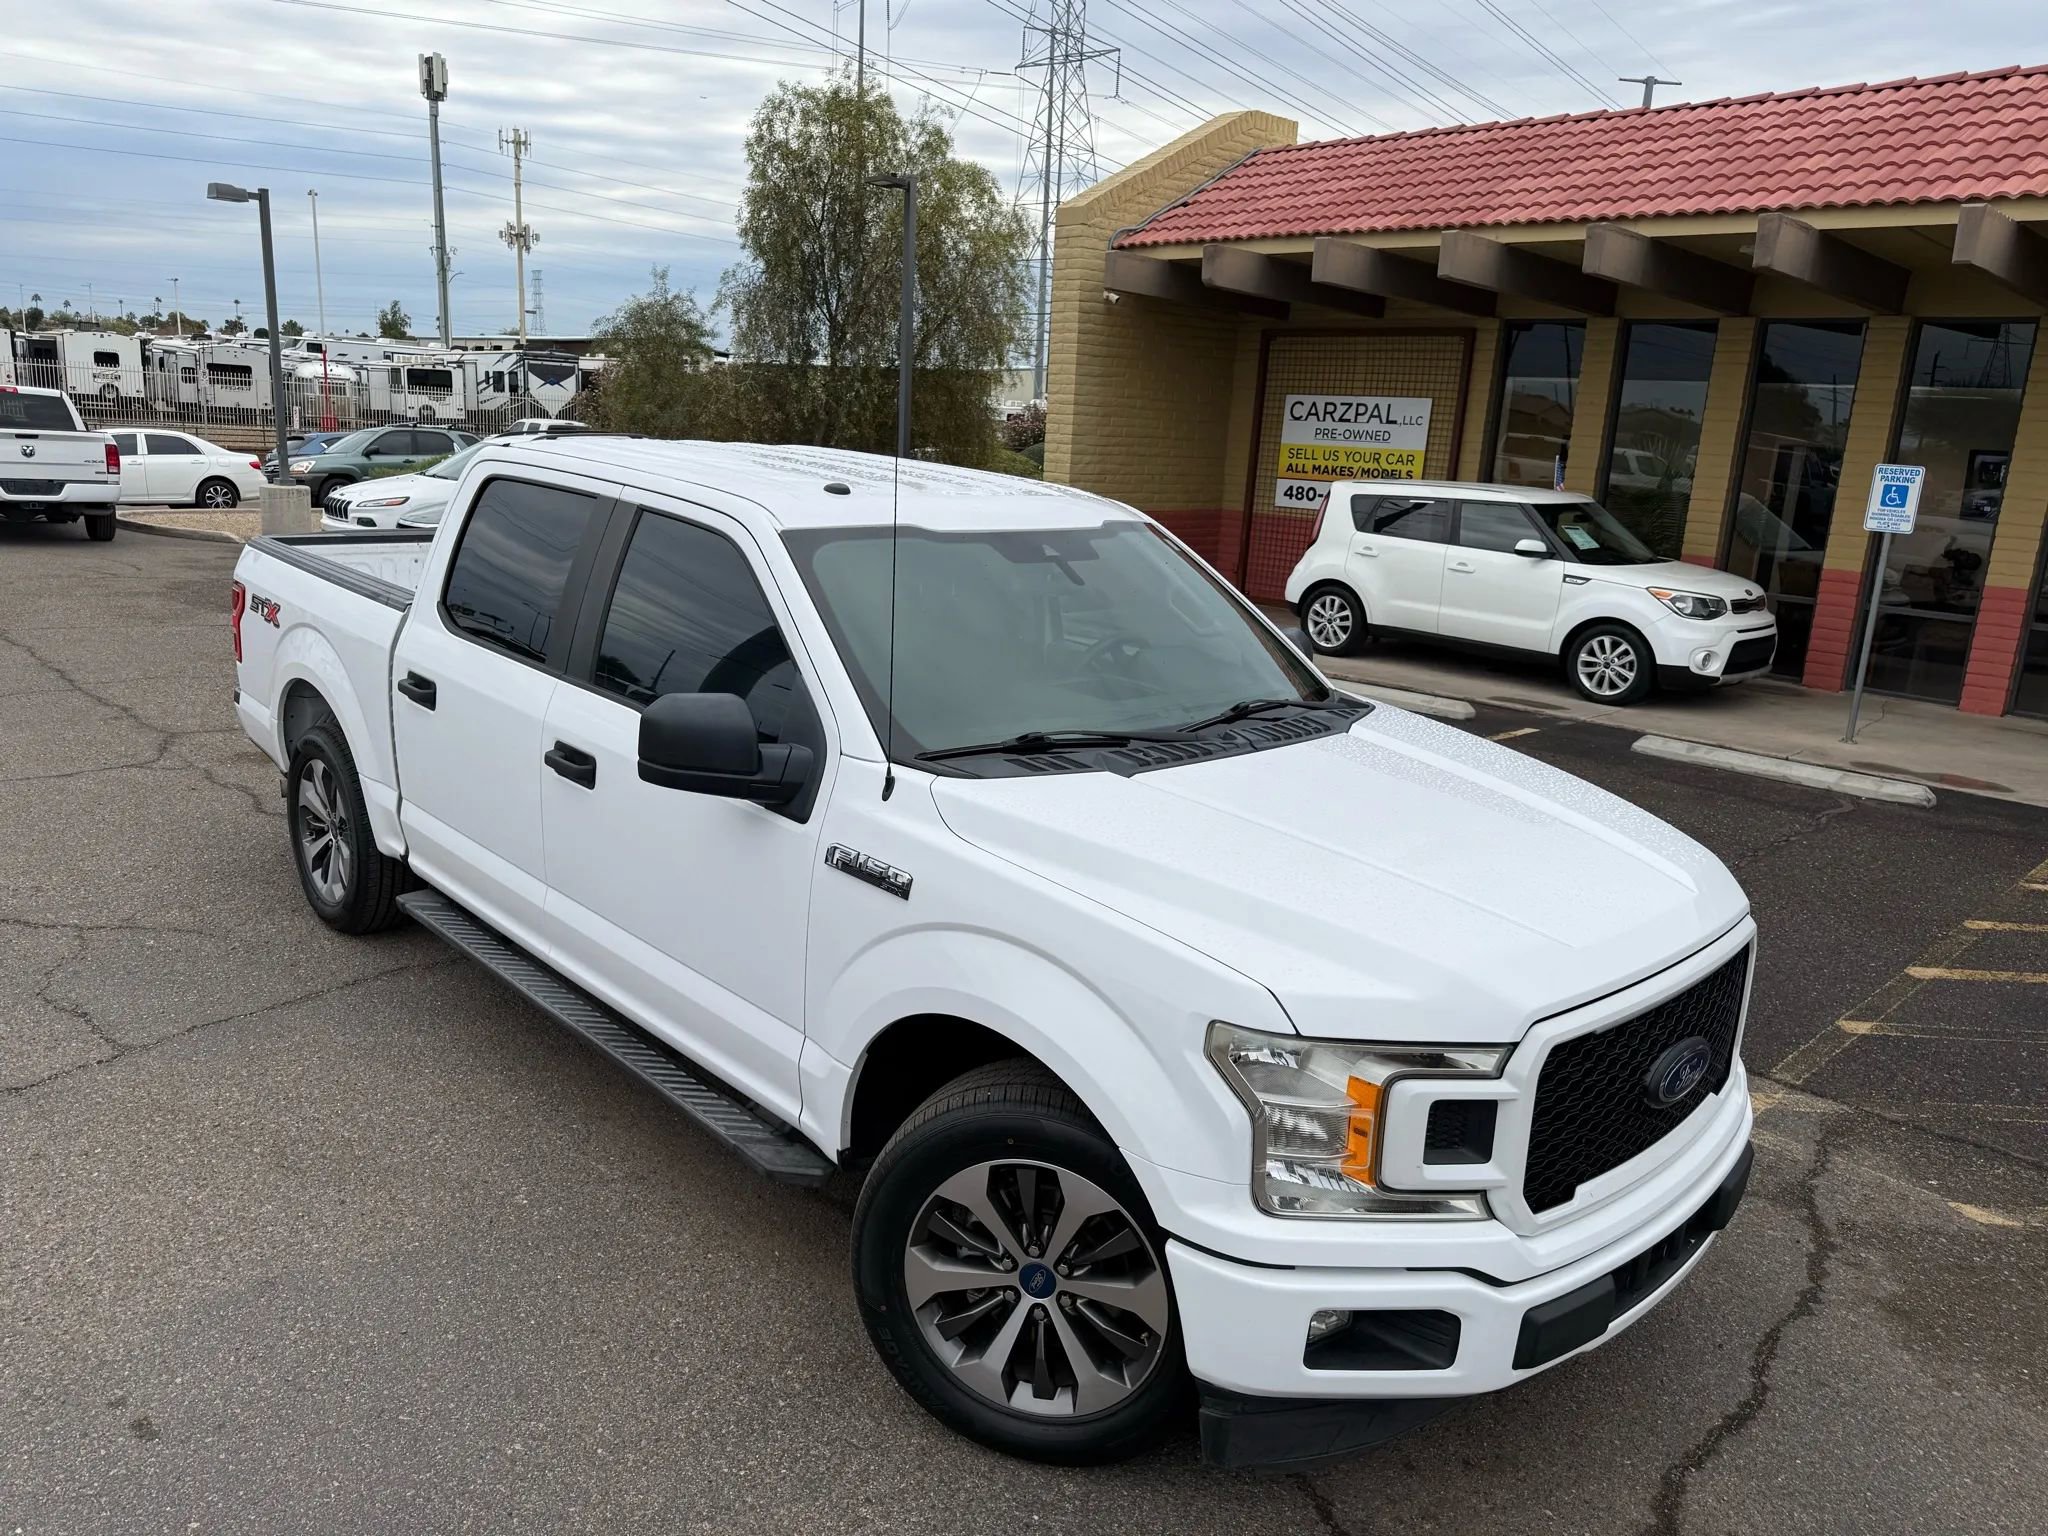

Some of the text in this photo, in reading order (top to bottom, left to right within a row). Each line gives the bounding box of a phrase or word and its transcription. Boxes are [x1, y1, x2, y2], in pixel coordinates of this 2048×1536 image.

[1289, 401, 1398, 424] CARZPAL
[1314, 428, 1391, 441] PRE-OWNED
[1288, 448, 1415, 466] SELL US YOUR CAR
[1286, 463, 1308, 474] ALL
[1878, 467, 1921, 477] RESERVED
[1880, 475, 1916, 484] PARKING
[1283, 485, 1331, 502] 480-
[250, 593, 281, 629] STX
